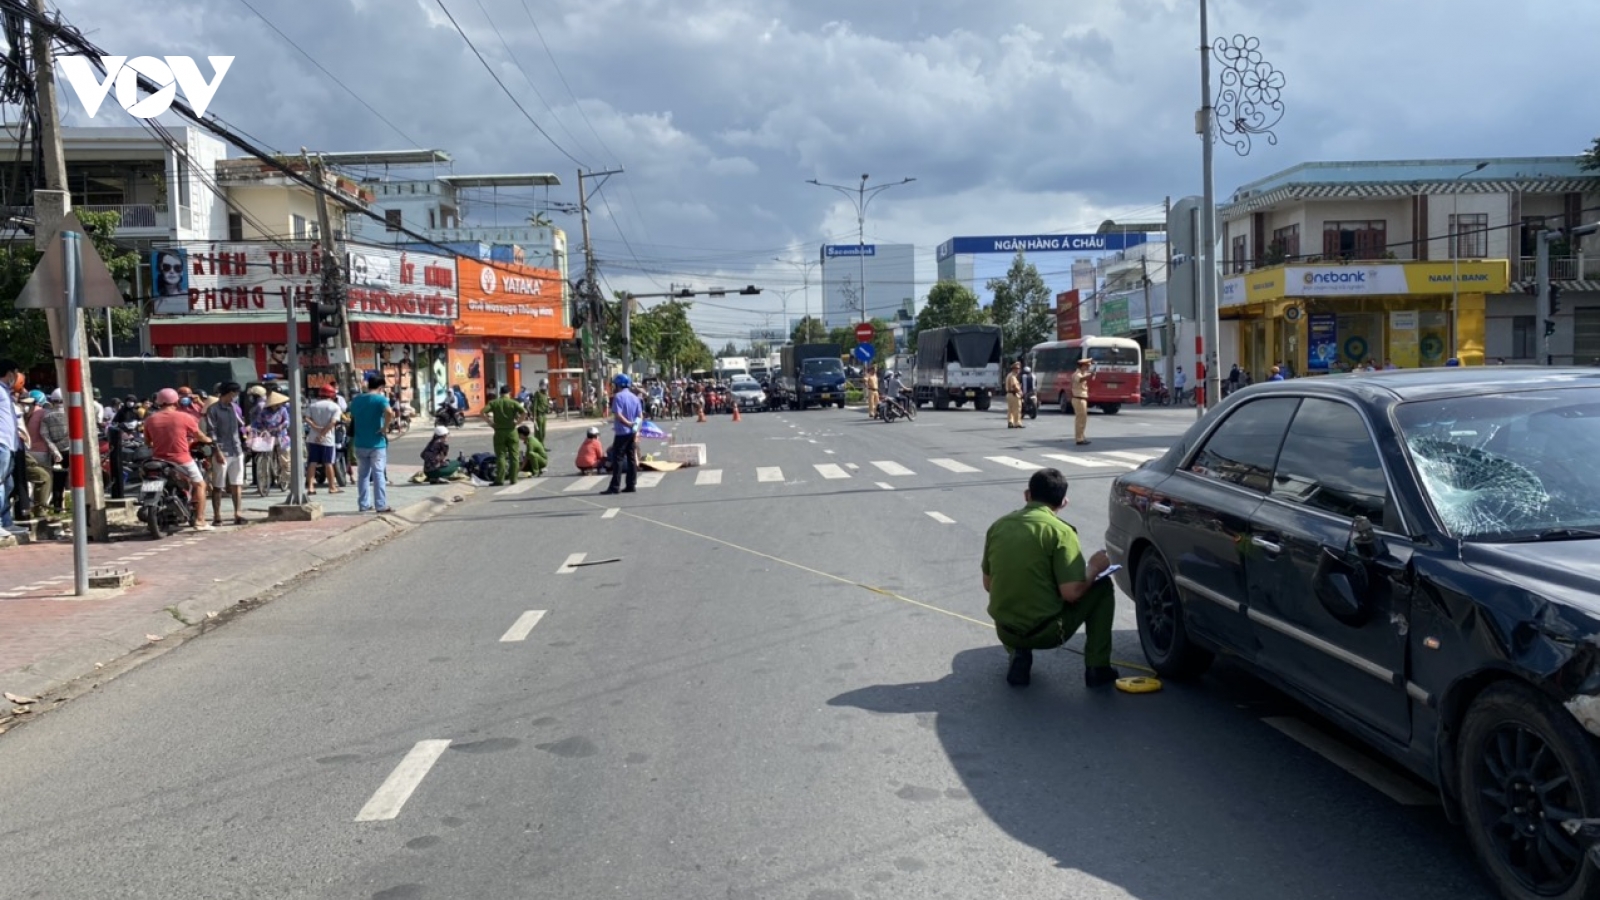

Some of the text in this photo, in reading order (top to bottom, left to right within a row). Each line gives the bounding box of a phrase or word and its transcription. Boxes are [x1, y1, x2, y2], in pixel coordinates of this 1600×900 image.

[994, 235, 1105, 250] NGÂN HÀNG Á CHÂU
[269, 240, 321, 275] THUỐ
[502, 276, 541, 296] YATAKA
[188, 286, 264, 312] PHONG
